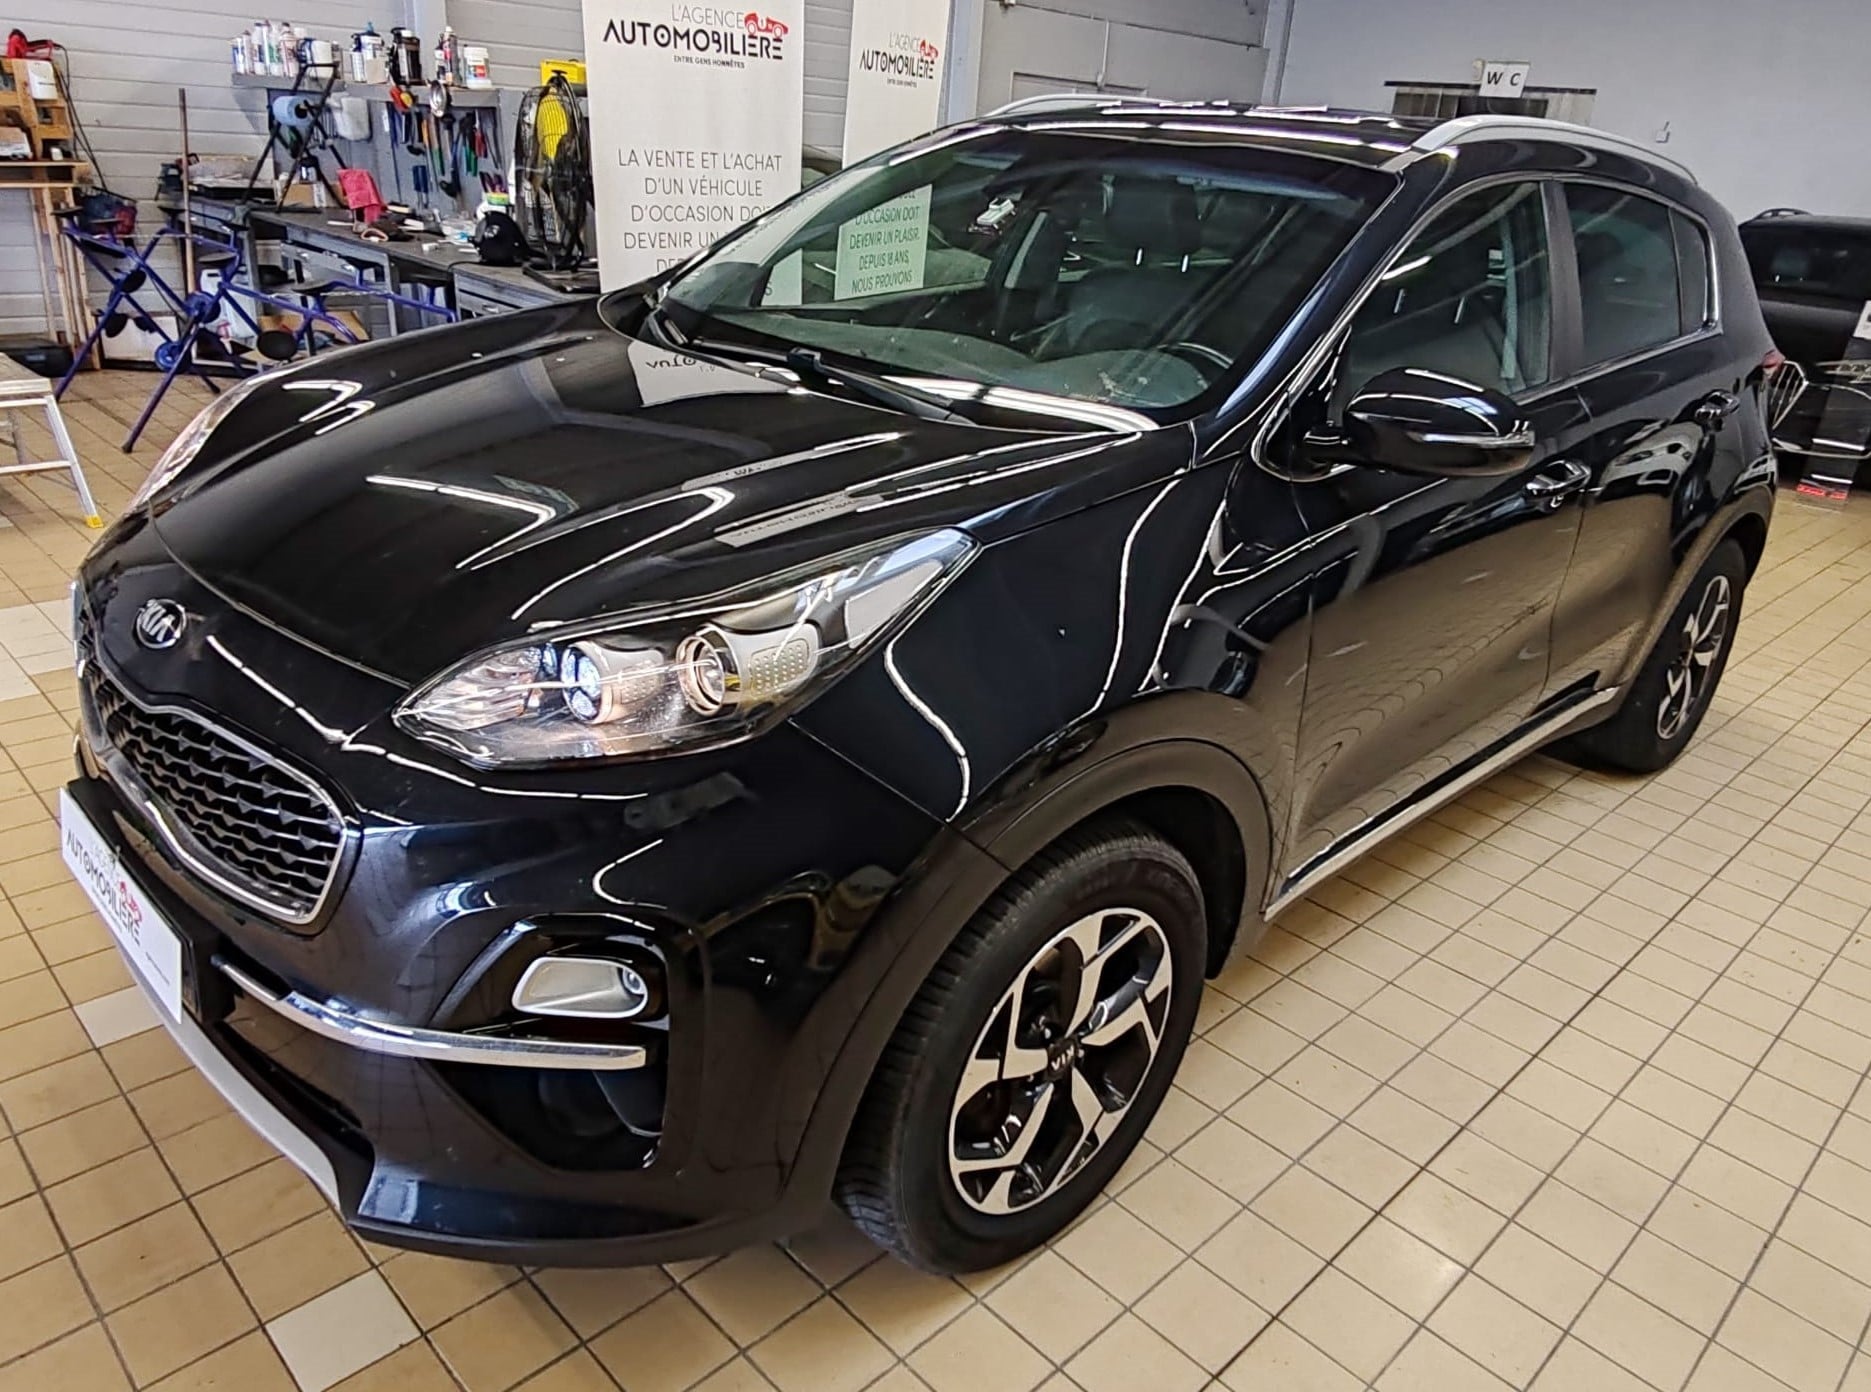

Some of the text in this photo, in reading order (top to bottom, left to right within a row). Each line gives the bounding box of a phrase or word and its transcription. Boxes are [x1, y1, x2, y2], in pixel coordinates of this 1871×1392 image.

[671, 3, 745, 29] L'AGENCE
[695, 56, 711, 65] GENS
[618, 149, 782, 172] LA VENTE ET L'ACHAT
[645, 175, 763, 197] D'UN VÉHICULE
[631, 205, 733, 222] D'OCCASION
[624, 231, 692, 249] DEVENIR
[850, 231, 882, 249] DEVENIR
[859, 252, 885, 270] DEPUIS
[852, 276, 873, 294] NOUS
